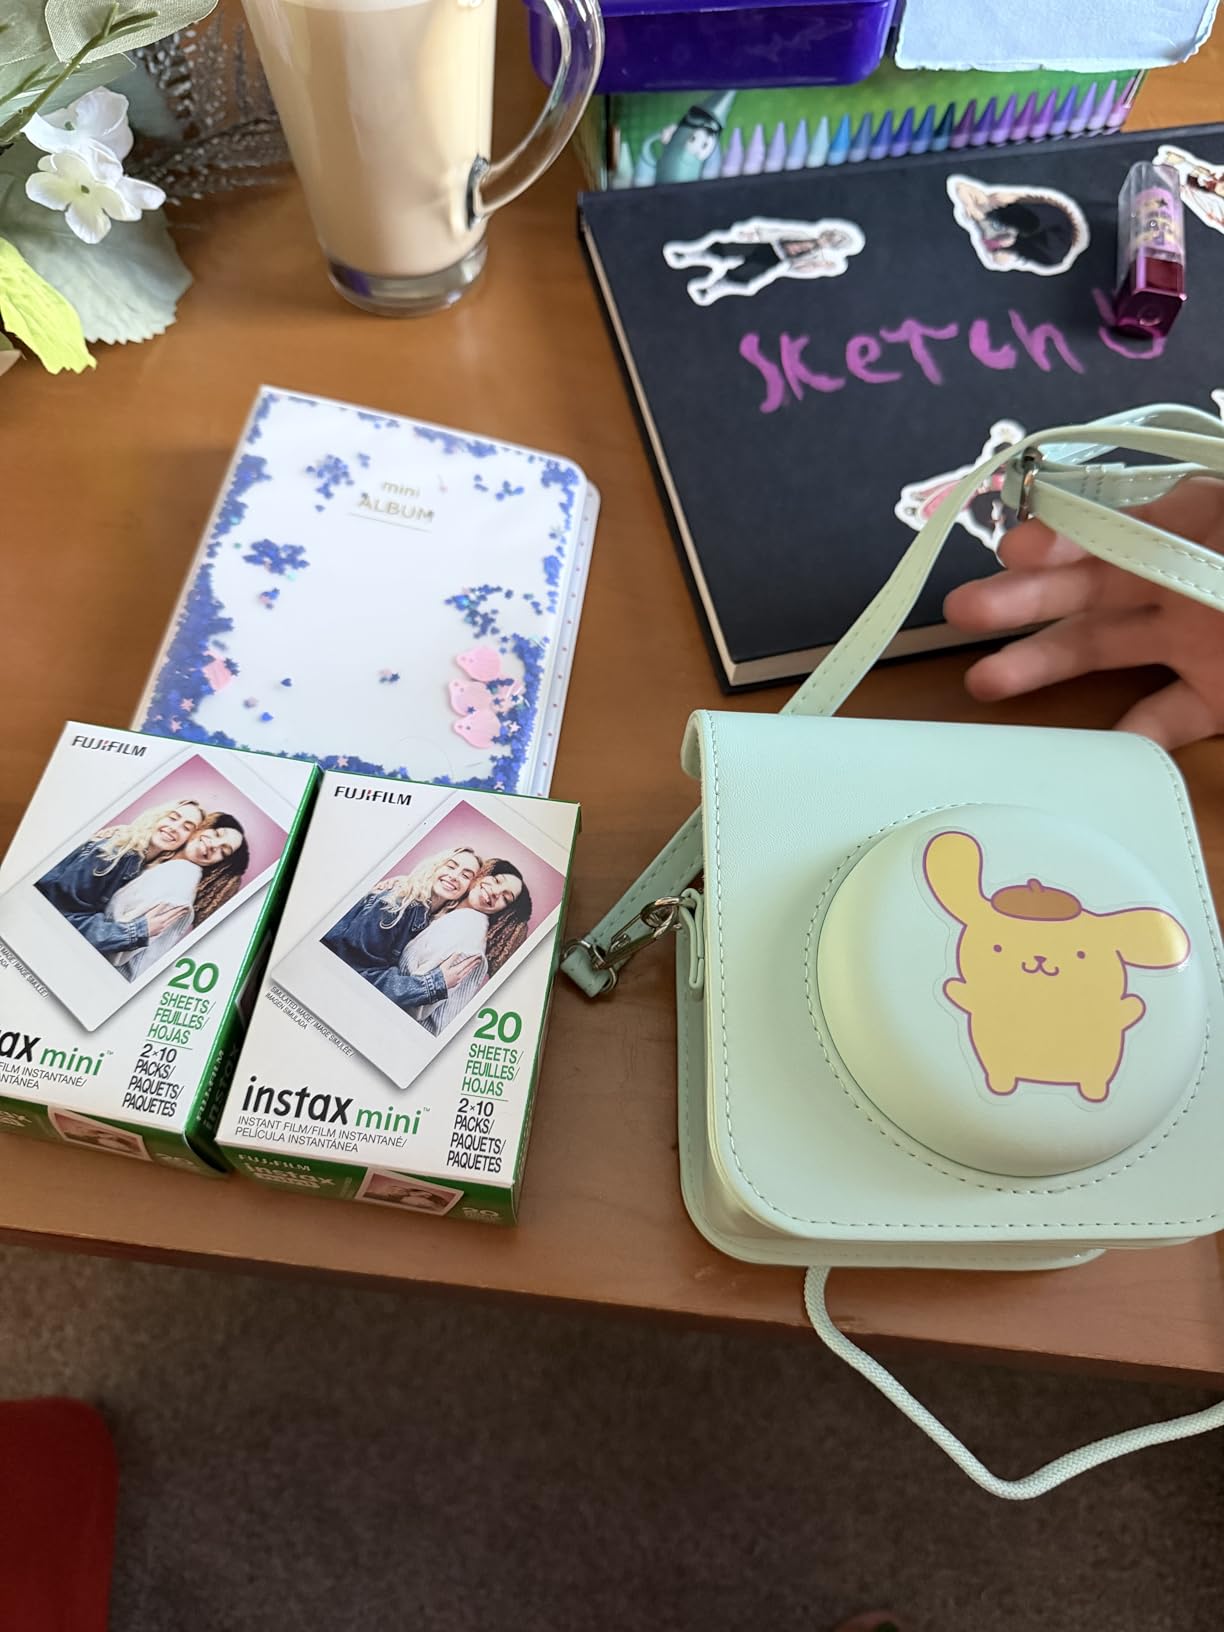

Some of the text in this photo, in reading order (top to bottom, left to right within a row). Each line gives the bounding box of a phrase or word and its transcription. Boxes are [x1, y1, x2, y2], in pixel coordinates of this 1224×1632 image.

[381, 480, 420, 497] mini
[358, 496, 434, 522] ALBUM
[71, 735, 147, 757] FUJIFILM
[334, 786, 412, 806] FUJIFILM
[167, 957, 220, 993] 20
[160, 991, 217, 1015] SHEETS/
[153, 1007, 210, 1031] FEUILLES/
[473, 1007, 522, 1043] 20
[147, 1023, 191, 1045] HOJAS
[0, 1030, 42, 1063] ax
[468, 1043, 524, 1065] SHEETS/
[134, 1059, 176, 1080] PACKS/
[464, 1060, 520, 1082] FEUILLES/
[0, 1073, 40, 1090] NTÁNEA
[127, 1075, 184, 1099] PAQUETS/
[461, 1076, 504, 1097] HOJAS
[122, 1093, 177, 1118] PAQUETES
[241, 1075, 354, 1126] instax
[238, 1115, 282, 1131] INSTANT
[454, 1114, 495, 1134] PACKS/
[235, 1124, 359, 1153] PELÍCULA INSTANTÁNEA
[450, 1132, 507, 1155] PAQUETS/
[446, 1150, 502, 1173] PAQUETES
